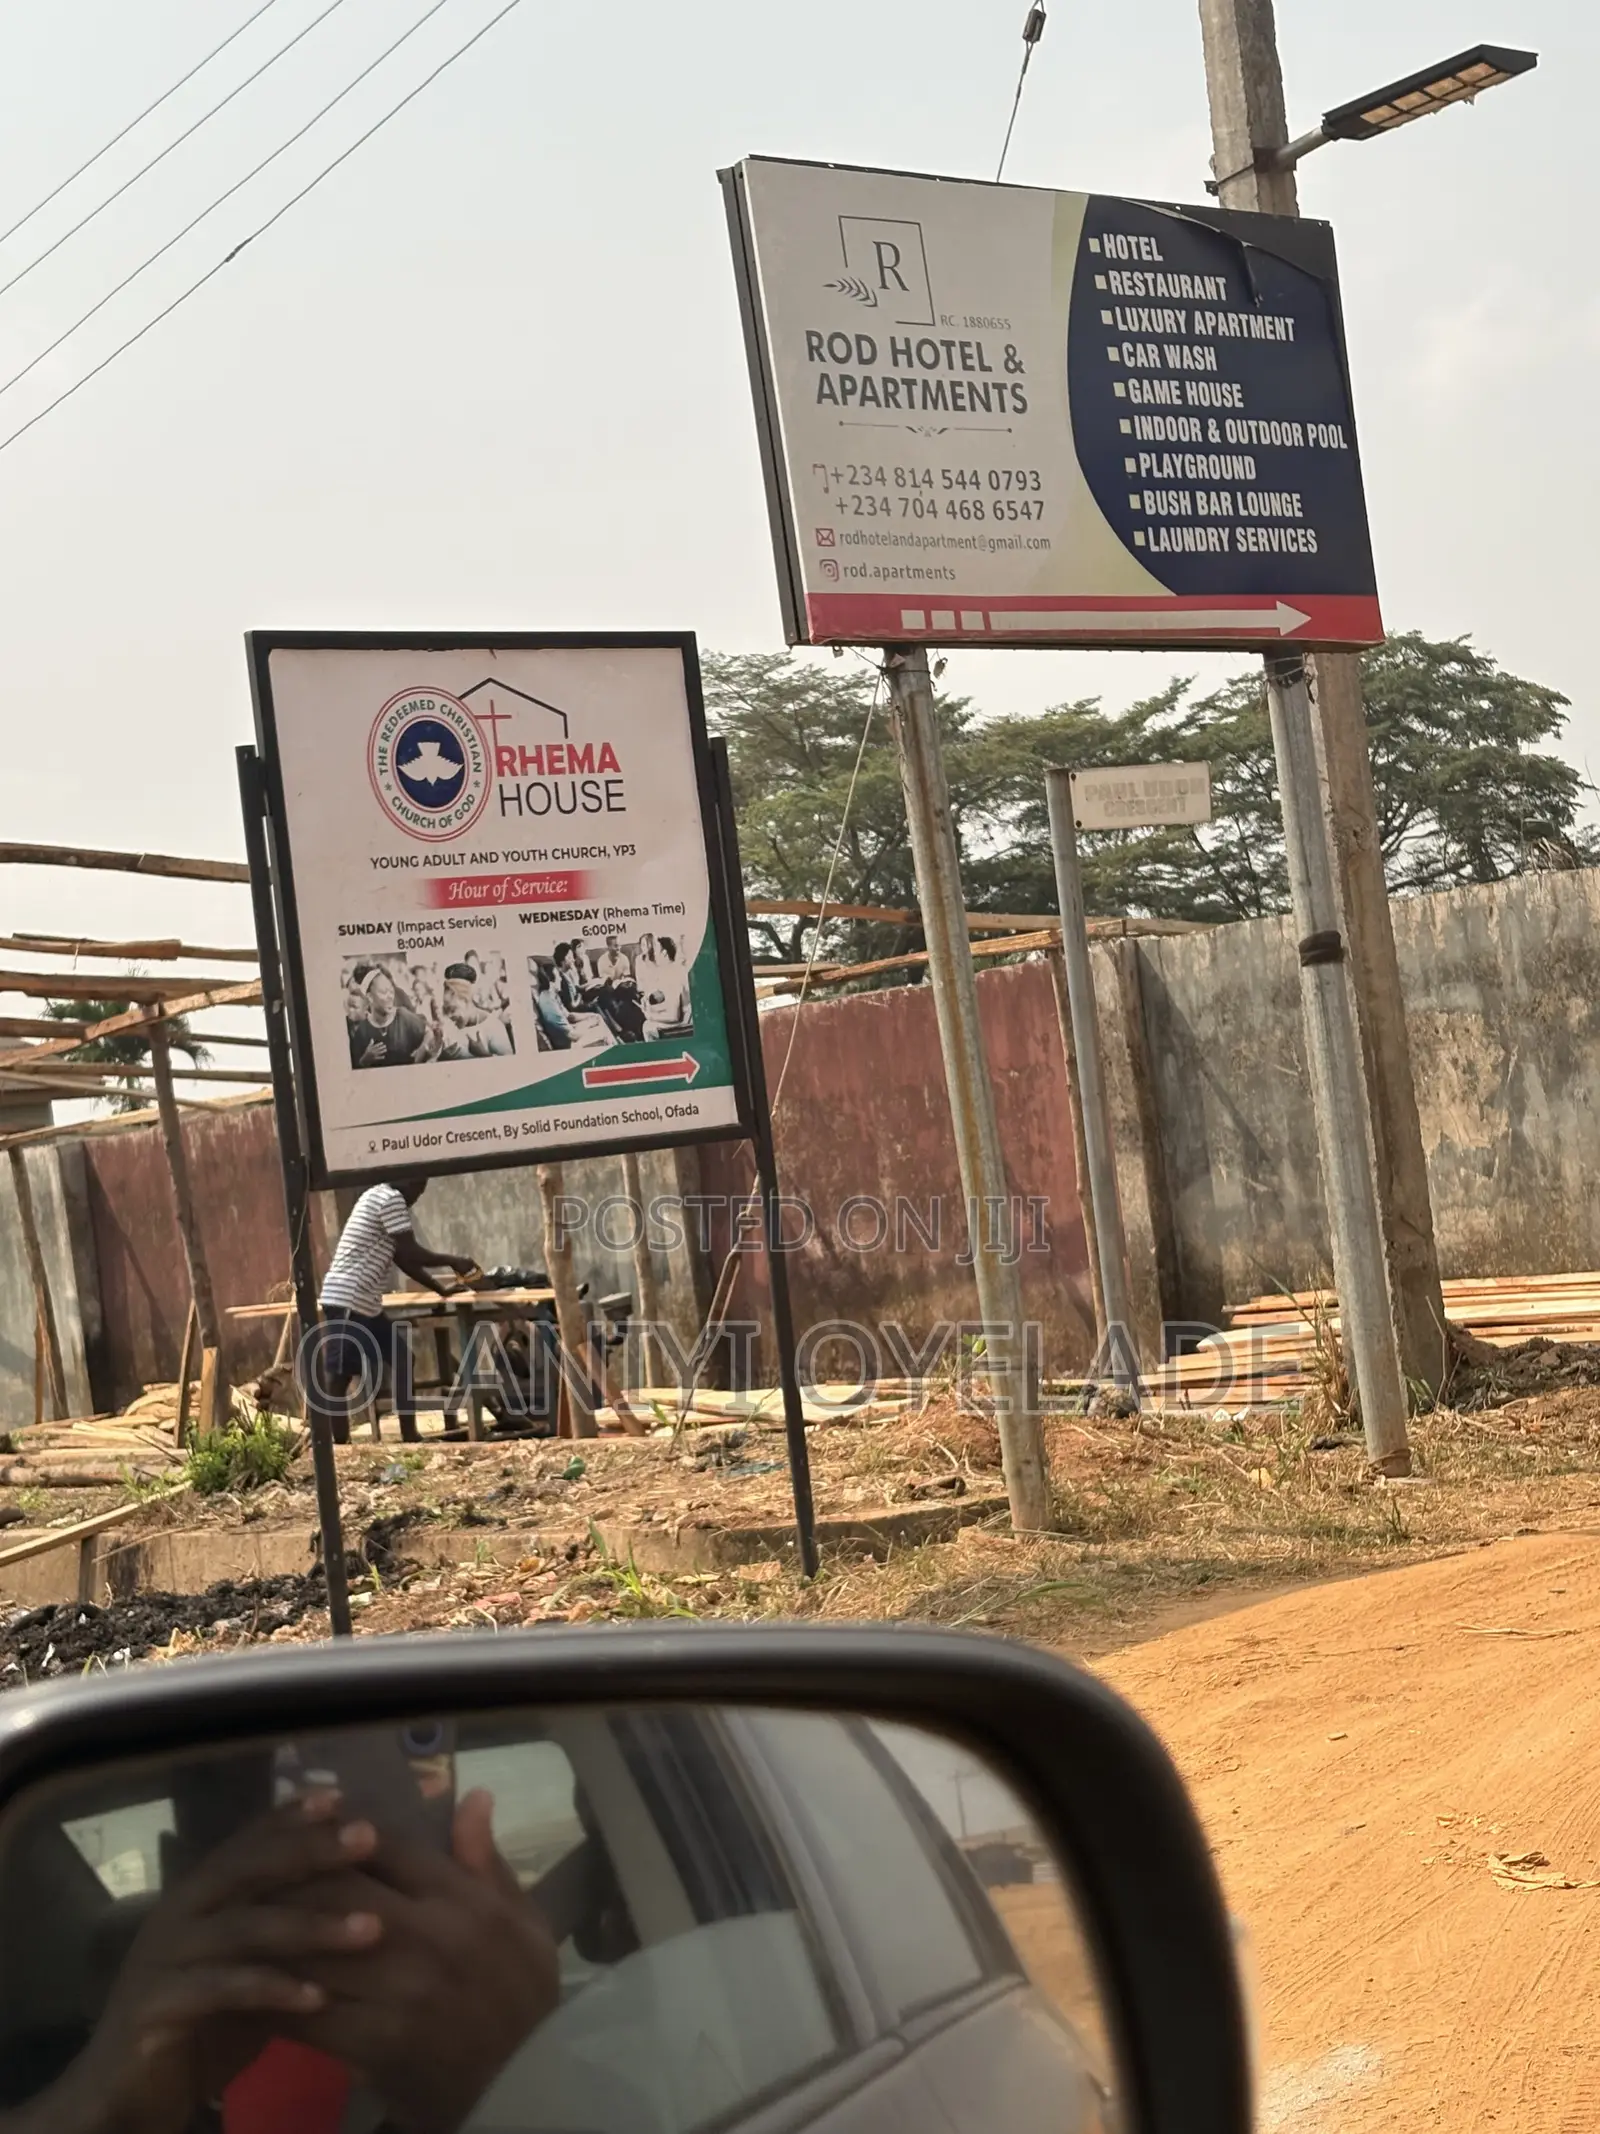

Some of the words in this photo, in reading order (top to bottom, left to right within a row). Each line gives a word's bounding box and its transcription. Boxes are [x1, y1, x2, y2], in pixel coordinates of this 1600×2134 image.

[1102, 233, 1164, 262] HOTEL
[872, 240, 910, 292] R
[1107, 270, 1227, 301] RESTAURANT
[963, 316, 1012, 330] 1880655
[1114, 306, 1187, 334] LUXURY
[1194, 313, 1295, 341] APARTMENT
[805, 329, 878, 366] ROD
[889, 335, 993, 373] HOTEL
[1003, 343, 1027, 374] &
[1121, 341, 1161, 369] CAR
[1163, 344, 1218, 371] WASH
[816, 372, 1029, 415] APARTMENTS
[1128, 378, 1182, 405] GAME
[1185, 381, 1244, 408] HOUSE
[1133, 414, 1203, 442] INDOOR
[1207, 419, 1222, 443] &
[1225, 420, 1304, 447] OUTDOOR
[1307, 424, 1348, 449] POOL
[830, 464, 888, 487] +234
[894, 466, 934, 489] 814
[941, 468, 982, 491] 544
[988, 469, 1042, 492] 0793
[1138, 452, 1257, 480] PLAYGROUND
[836, 495, 892, 517] +234
[898, 497, 938, 519] 704
[945, 499, 985, 520] 468
[992, 500, 1045, 521] 6547
[1143, 490, 1192, 516] BUSH
[1195, 492, 1233, 517] BAR
[1236, 494, 1304, 518] LOUNGE
[839, 530, 1051, 553] rodhotelandapartment@gmail.com
[1148, 526, 1230, 553] LAUNDRY
[1235, 527, 1318, 554] SERVICES
[843, 561, 956, 581] rod.apartments
[381, 699, 436, 742] REDEEMED
[439, 703, 482, 773] CHRISTIAN
[378, 746, 389, 775] THE
[496, 742, 622, 778] RHEMA
[391, 796, 436, 829] CHURCH
[438, 814, 453, 829] OF
[454, 794, 476, 820] GOD
[499, 779, 627, 817] HOUSE
[370, 855, 420, 870] YOUNG
[422, 853, 466, 868] ADULT
[469, 851, 499, 865] AND
[501, 849, 548, 863] YOUTH
[551, 846, 611, 861] CHURCH,
[613, 844, 636, 857] YP3
[448, 878, 489, 901] Hour
[492, 878, 508, 904] of
[511, 878, 569, 897] Service:
[338, 921, 393, 937] SUNDAY
[397, 919, 446, 934] (Impact
[449, 915, 497, 931] Service)
[518, 908, 600, 925] WEDNESDAY
[602, 905, 650, 920] (Rhema
[651, 902, 686, 917] Time)
[397, 936, 445, 950] 8:00AM
[581, 923, 627, 937] 6:00PM
[382, 1137, 409, 1152] Paul
[413, 1134, 443, 1148] Udor
[446, 1127, 501, 1145] Crescent,
[503, 1124, 519, 1140] By
[521, 1120, 551, 1136] Solid
[553, 1111, 619, 1133] Foundation
[621, 1107, 663, 1125] School,
[664, 1102, 700, 1118] Ofada
